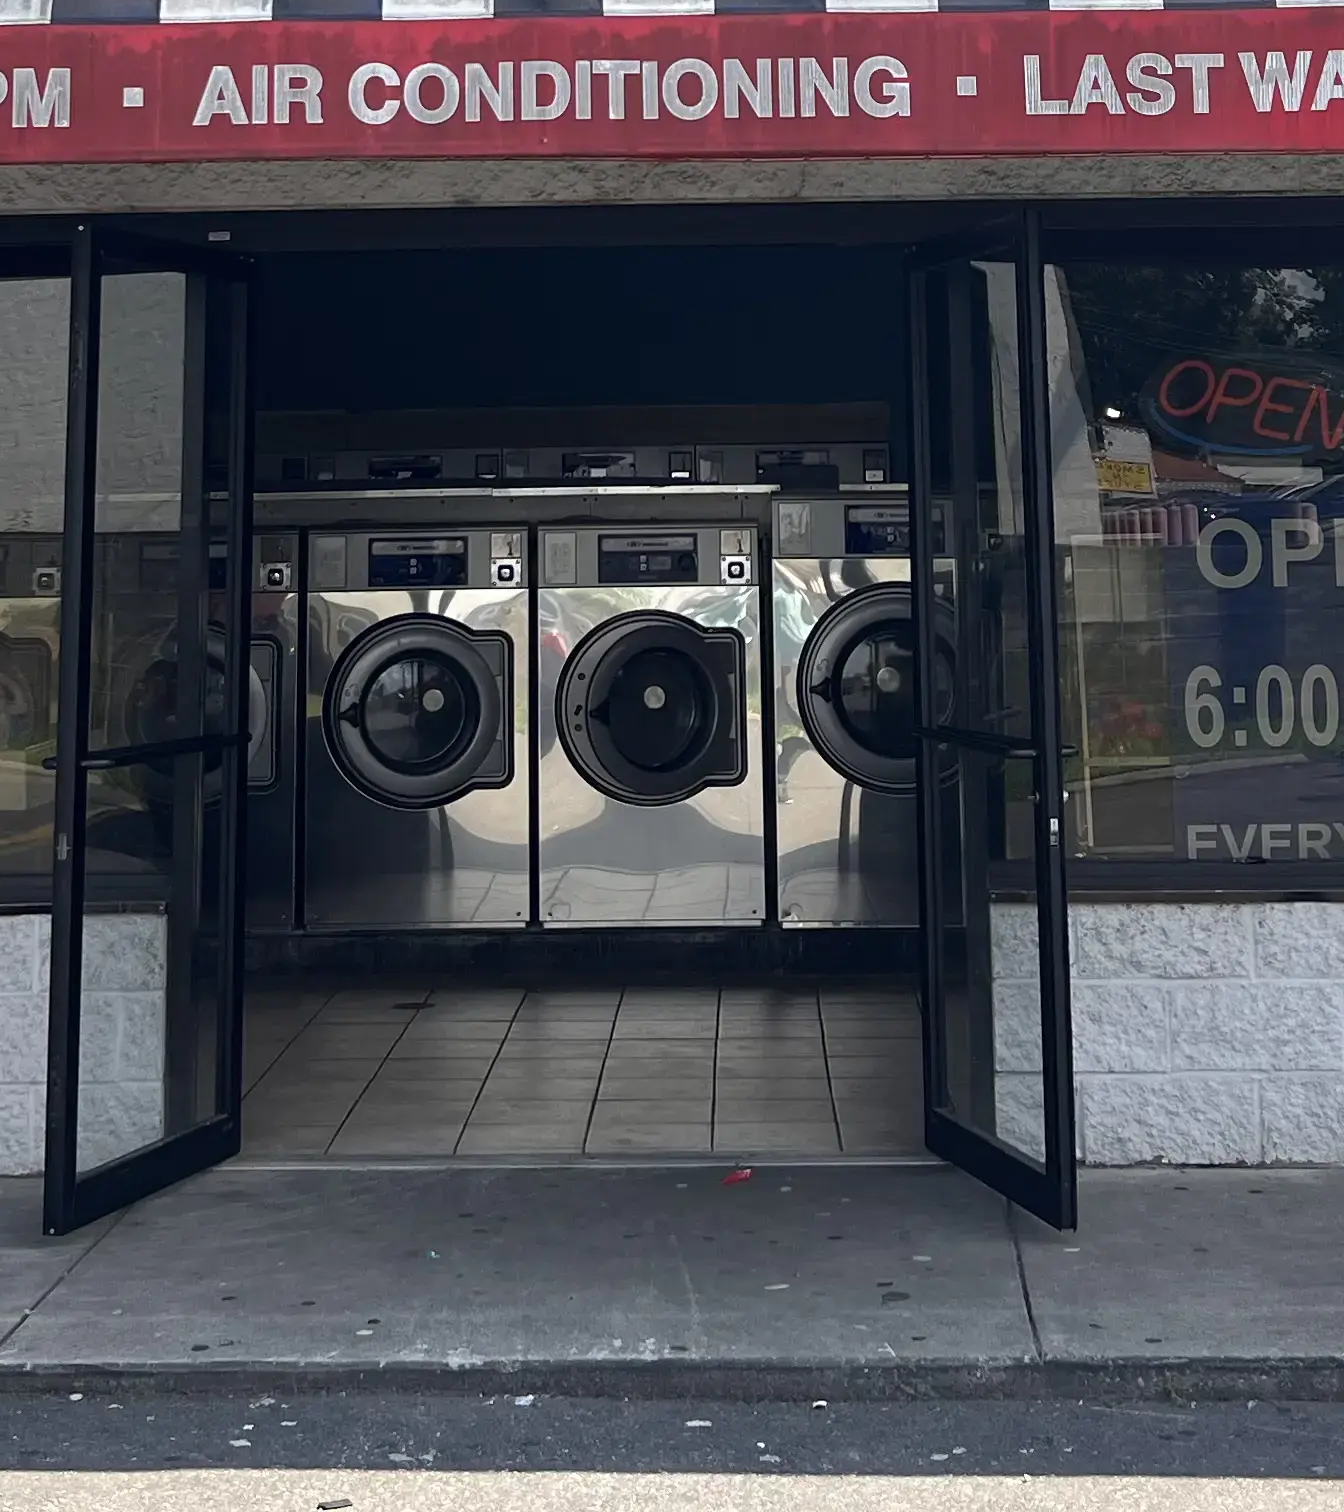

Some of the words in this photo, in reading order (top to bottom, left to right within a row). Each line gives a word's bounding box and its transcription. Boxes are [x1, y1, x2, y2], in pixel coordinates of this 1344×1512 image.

[191, 63, 324, 126] AIR
[348, 55, 911, 125] CONDITIONING
[1023, 53, 1224, 116] LAST
[1184, 664, 1340, 748] 6:00
